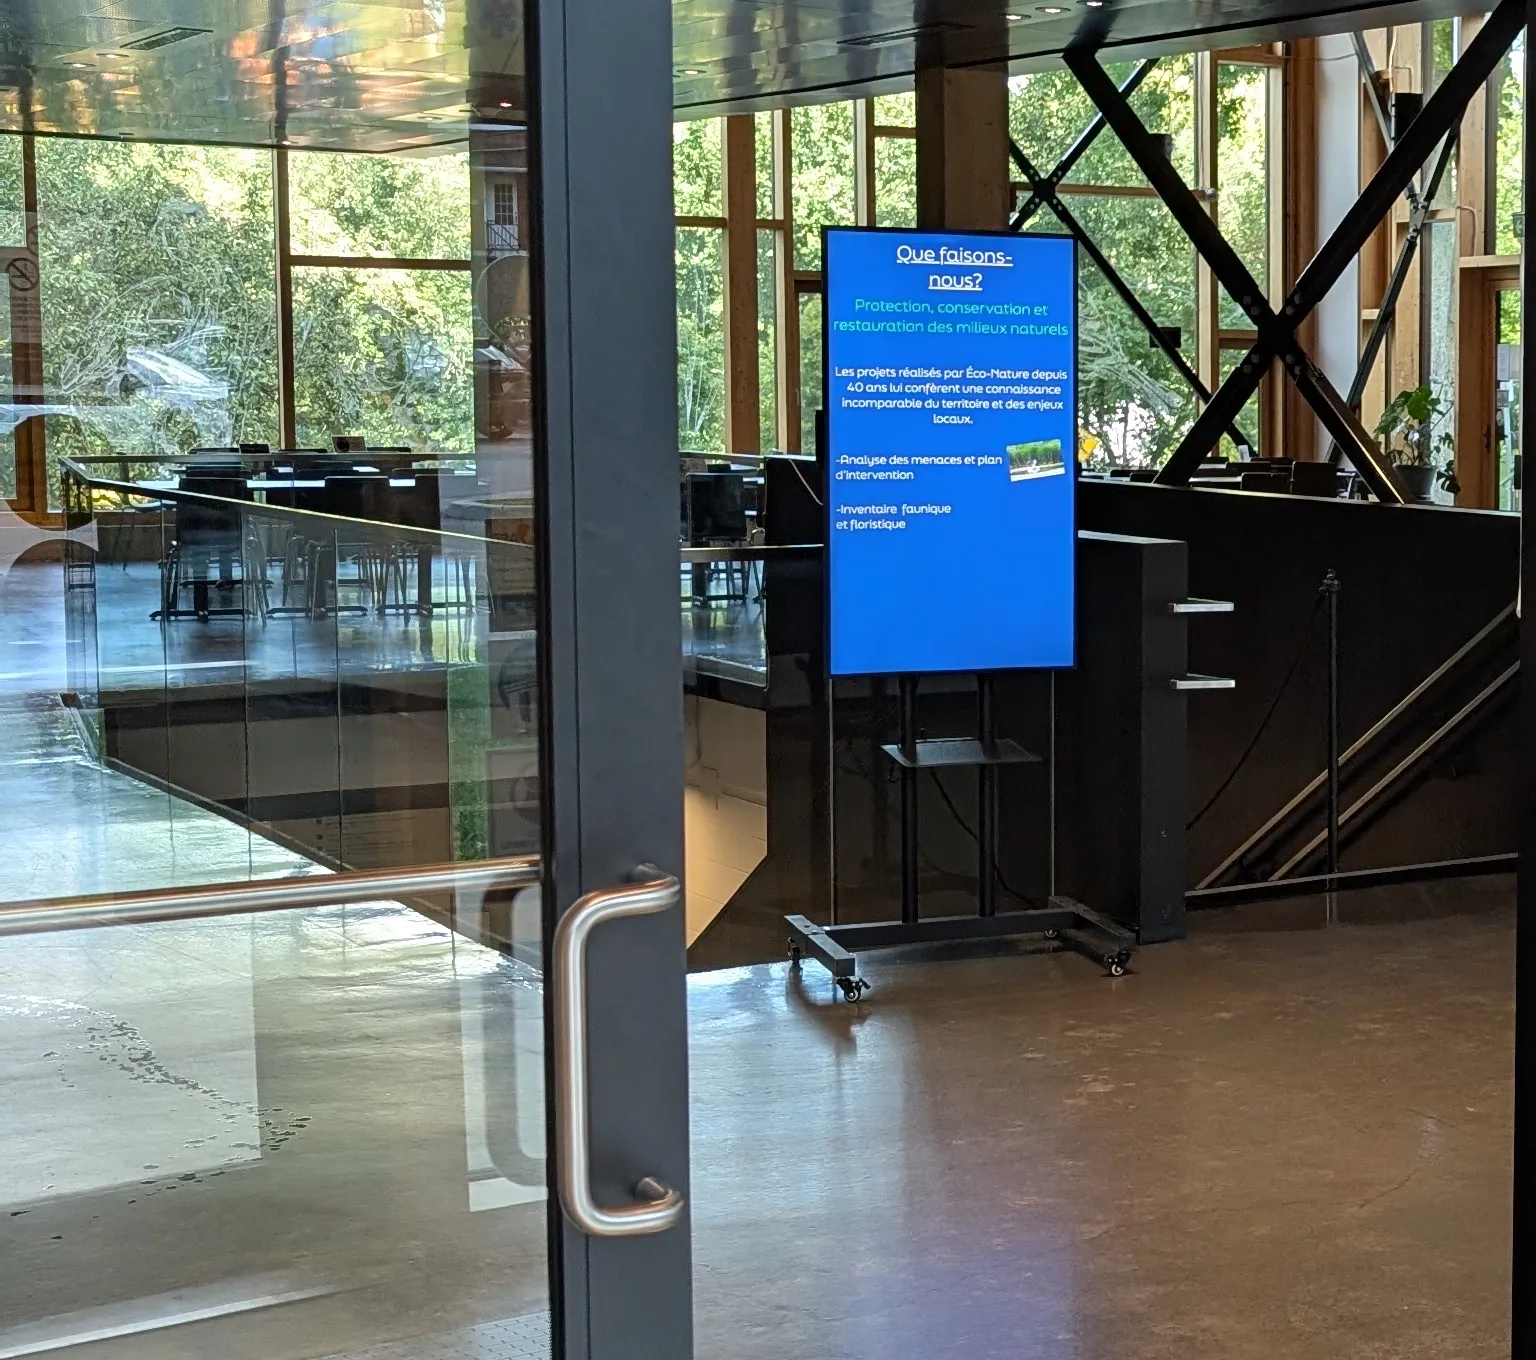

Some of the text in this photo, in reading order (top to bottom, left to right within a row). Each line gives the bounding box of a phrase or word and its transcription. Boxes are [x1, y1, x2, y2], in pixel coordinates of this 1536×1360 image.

[896, 245, 1013, 266] Que faisons-
[929, 272, 983, 290] nous?
[855, 299, 1048, 316] Protection, conservation et
[833, 319, 1069, 336] restauration des milieux naturels
[835, 365, 1068, 381] Les projets réalisés par Éco-Nature depuis
[846, 381, 1062, 395] 40 ans lui confèrent une connaissance
[841, 397, 1064, 412] incomparable du territoire et des enjeux
[932, 413, 974, 425] locaux.
[835, 454, 1003, 467] -Analyse des menaces et plan
[835, 470, 915, 481] d'intervention
[835, 503, 952, 517] -Inventaire faunique
[836, 518, 906, 531] et floristique
